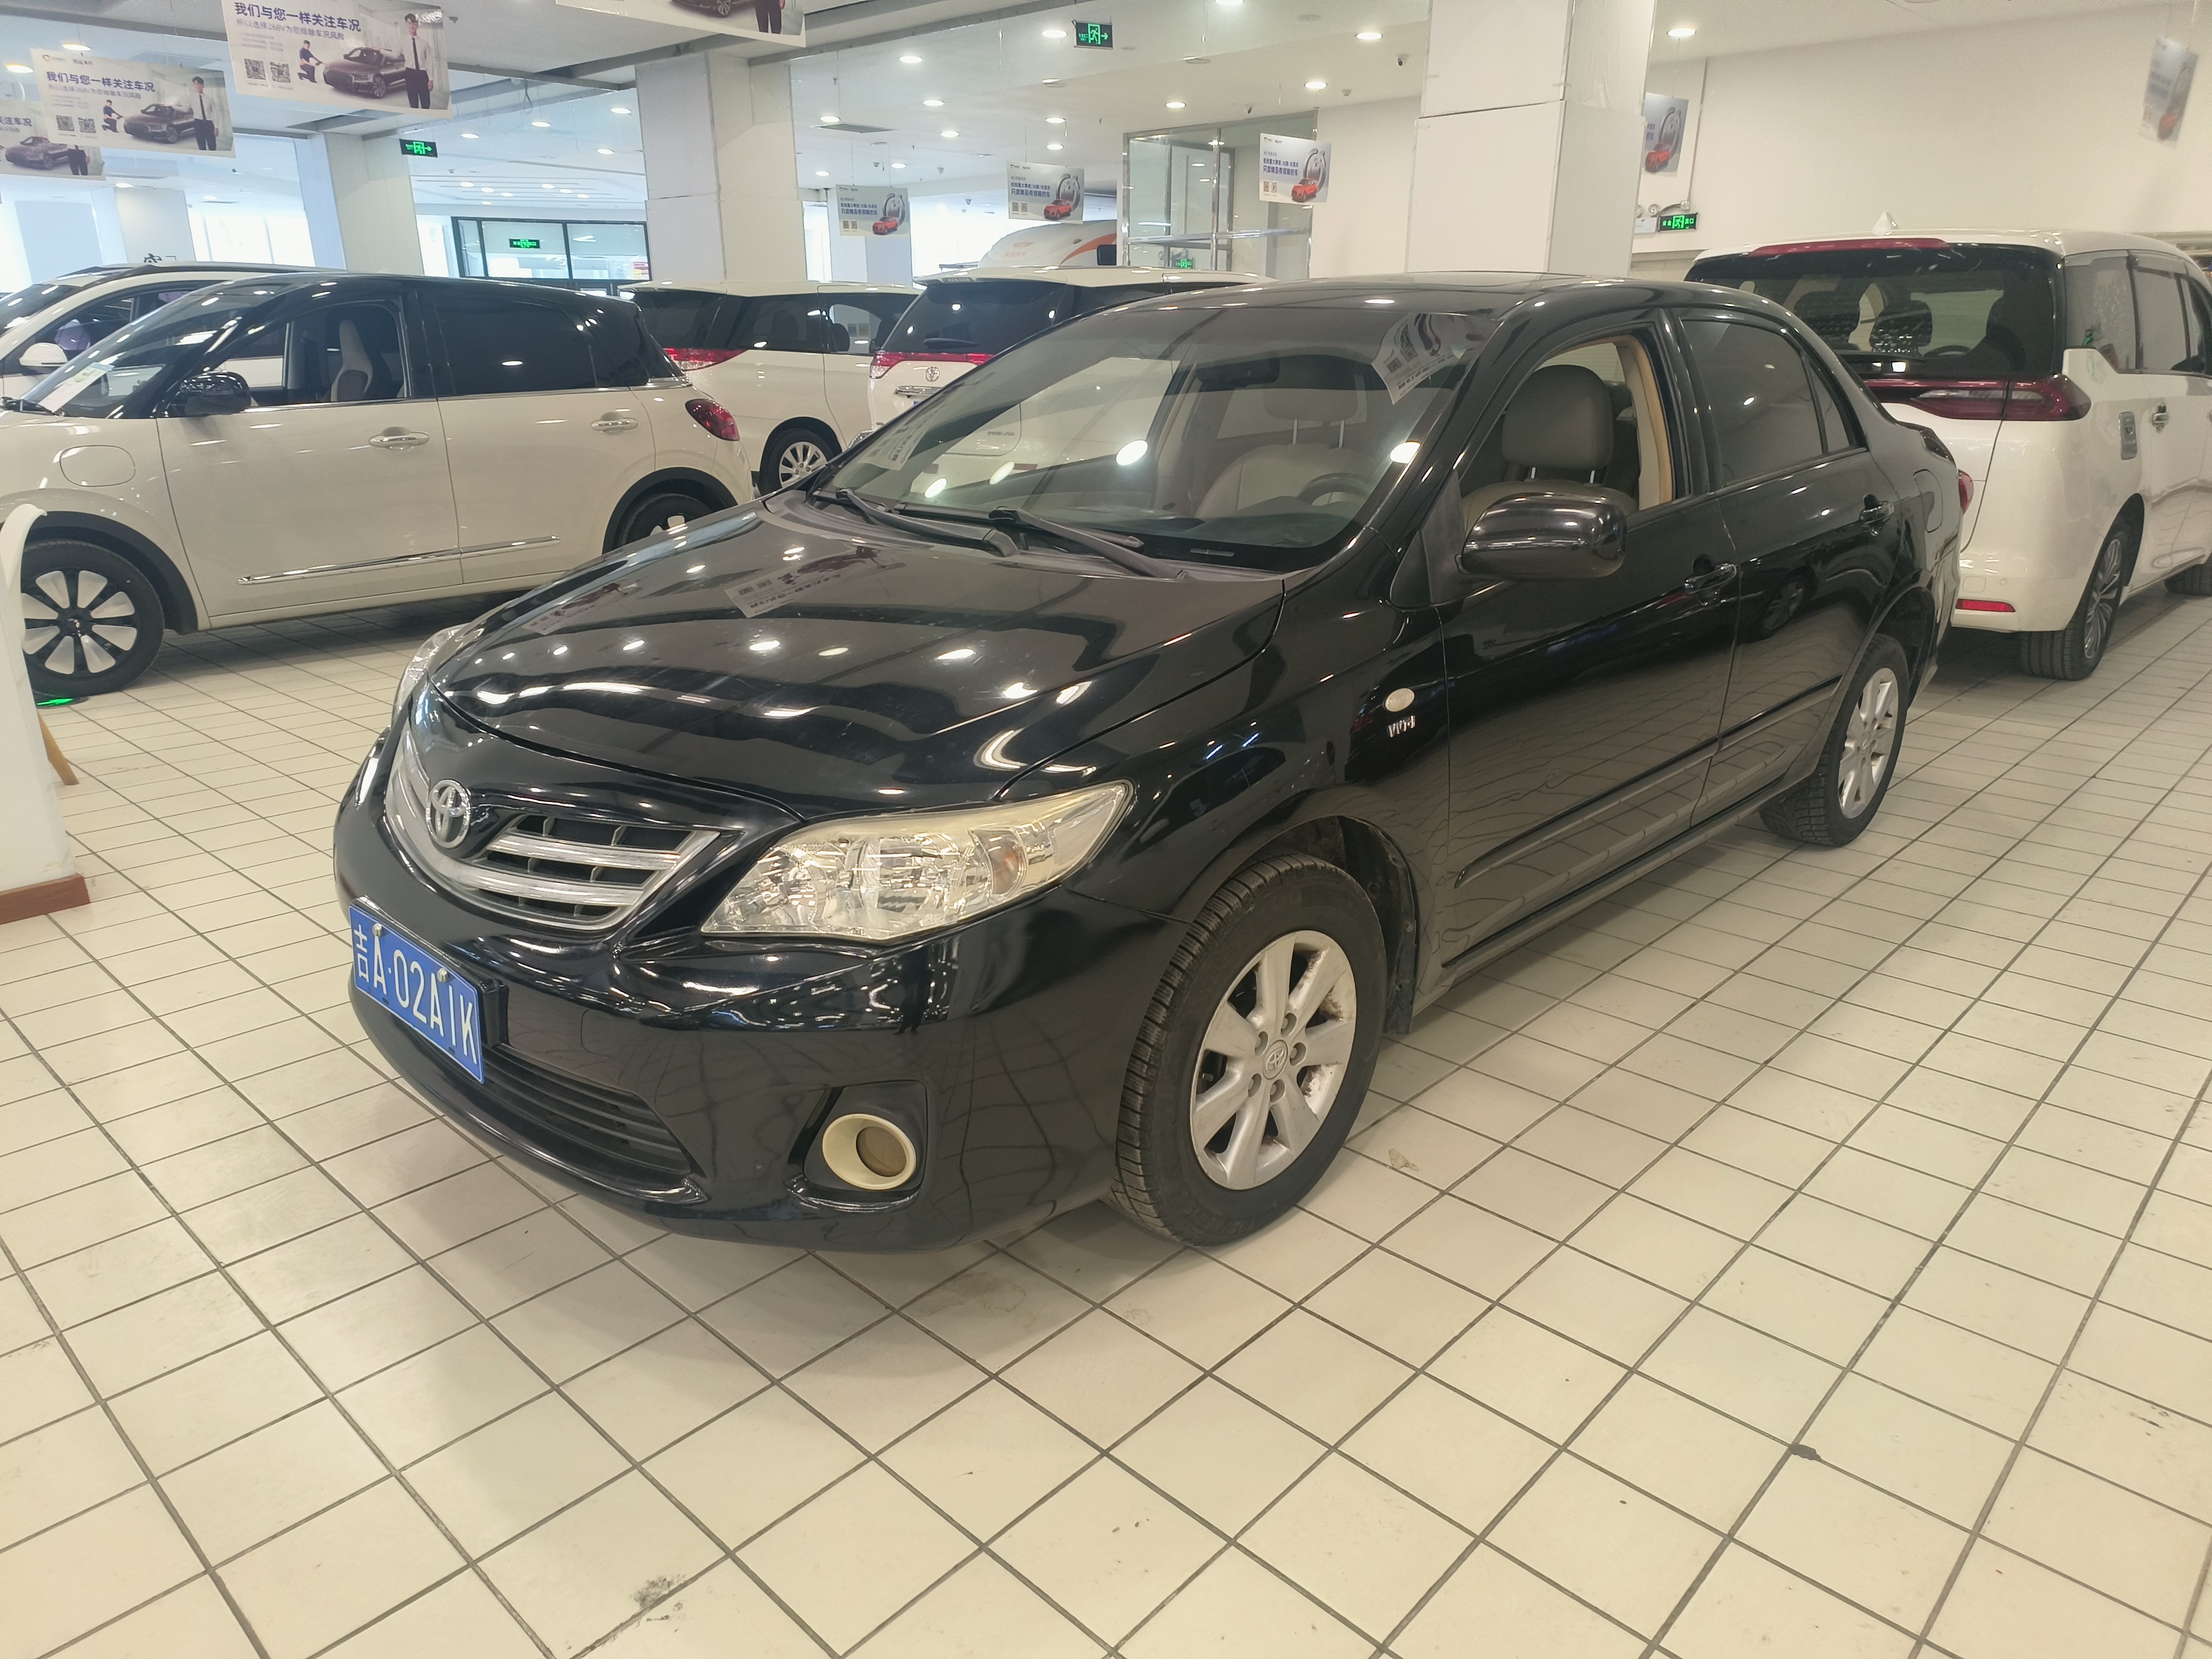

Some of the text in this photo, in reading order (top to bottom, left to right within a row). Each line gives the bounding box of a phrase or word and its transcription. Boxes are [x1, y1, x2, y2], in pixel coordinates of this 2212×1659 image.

[234, 2, 361, 32] 我们与您一样关注车况
[46, 71, 155, 92] 我们与您一样关注车况
